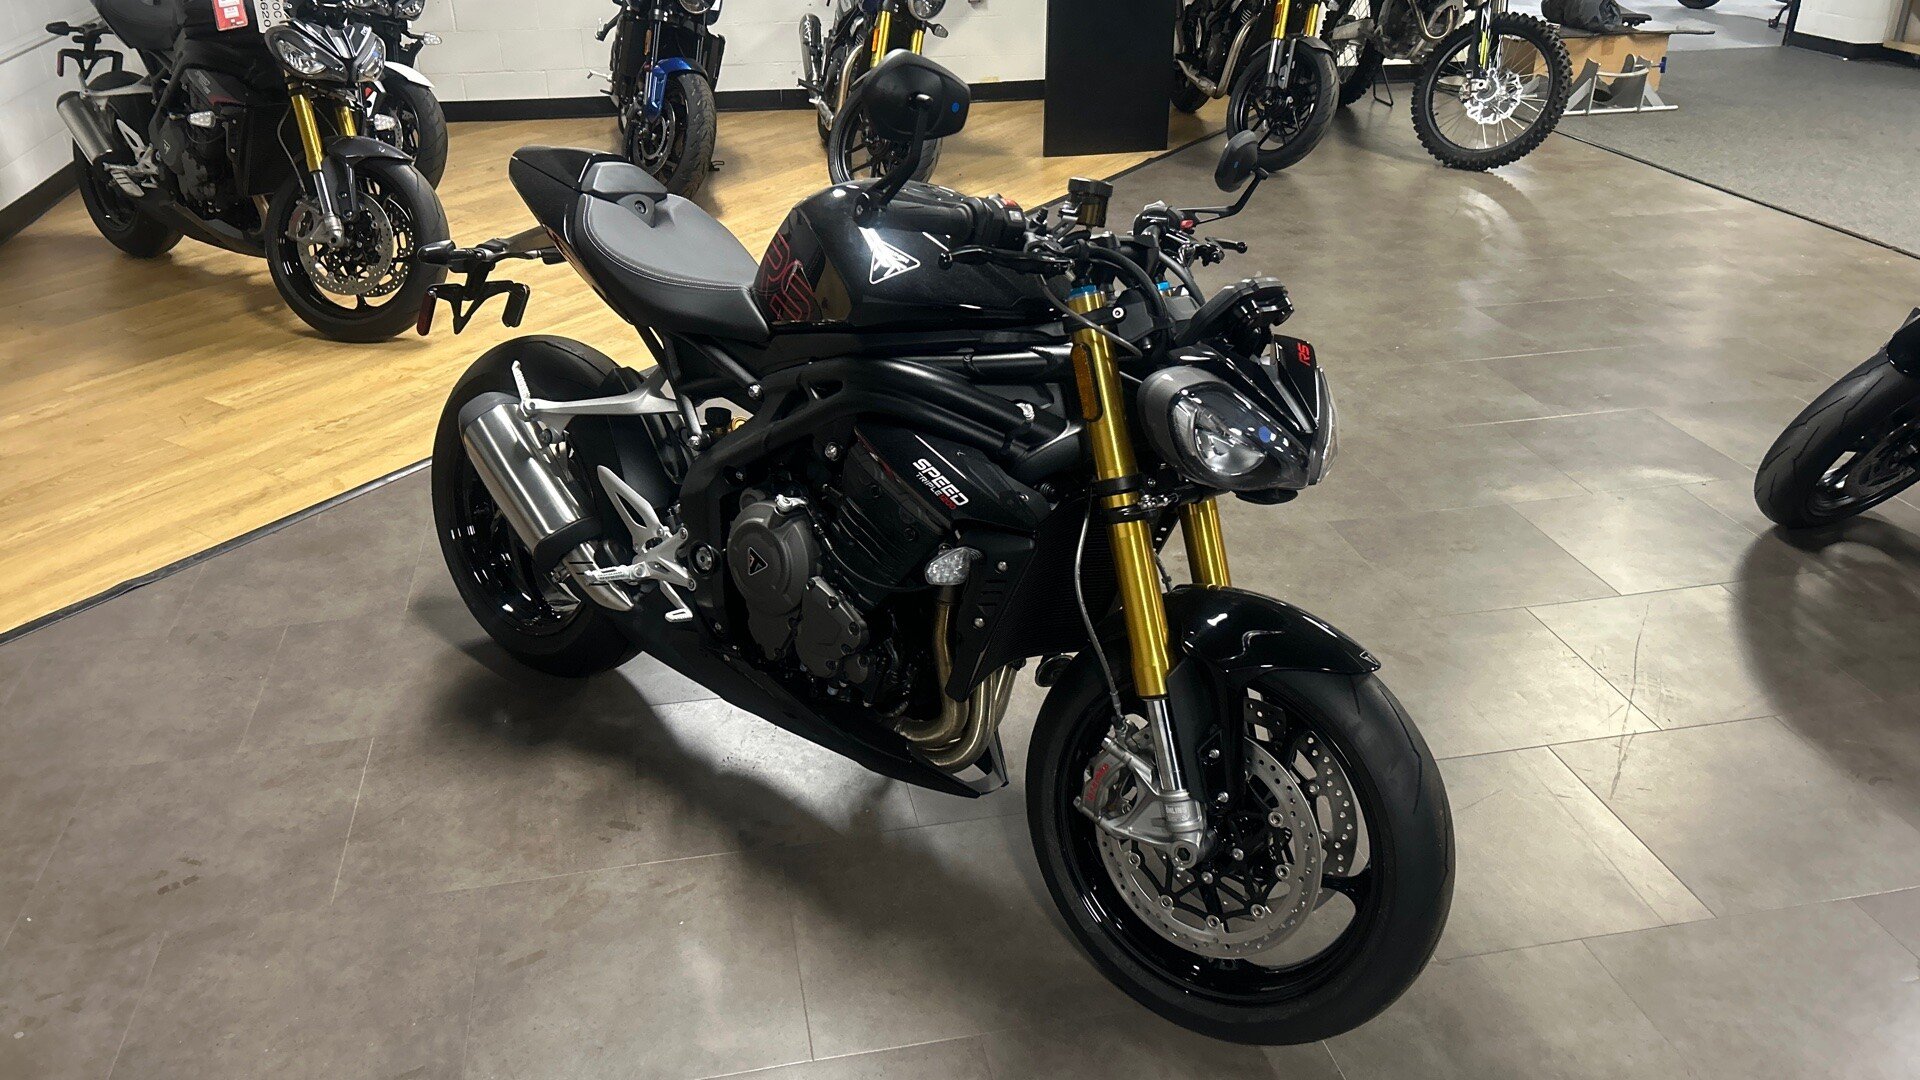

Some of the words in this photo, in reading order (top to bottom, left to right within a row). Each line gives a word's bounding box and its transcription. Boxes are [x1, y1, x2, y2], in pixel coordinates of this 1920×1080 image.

[260, 0, 272, 28] 620
[272, 0, 283, 19] OC
[1297, 341, 1311, 367] RS
[912, 458, 969, 506] SPEED
